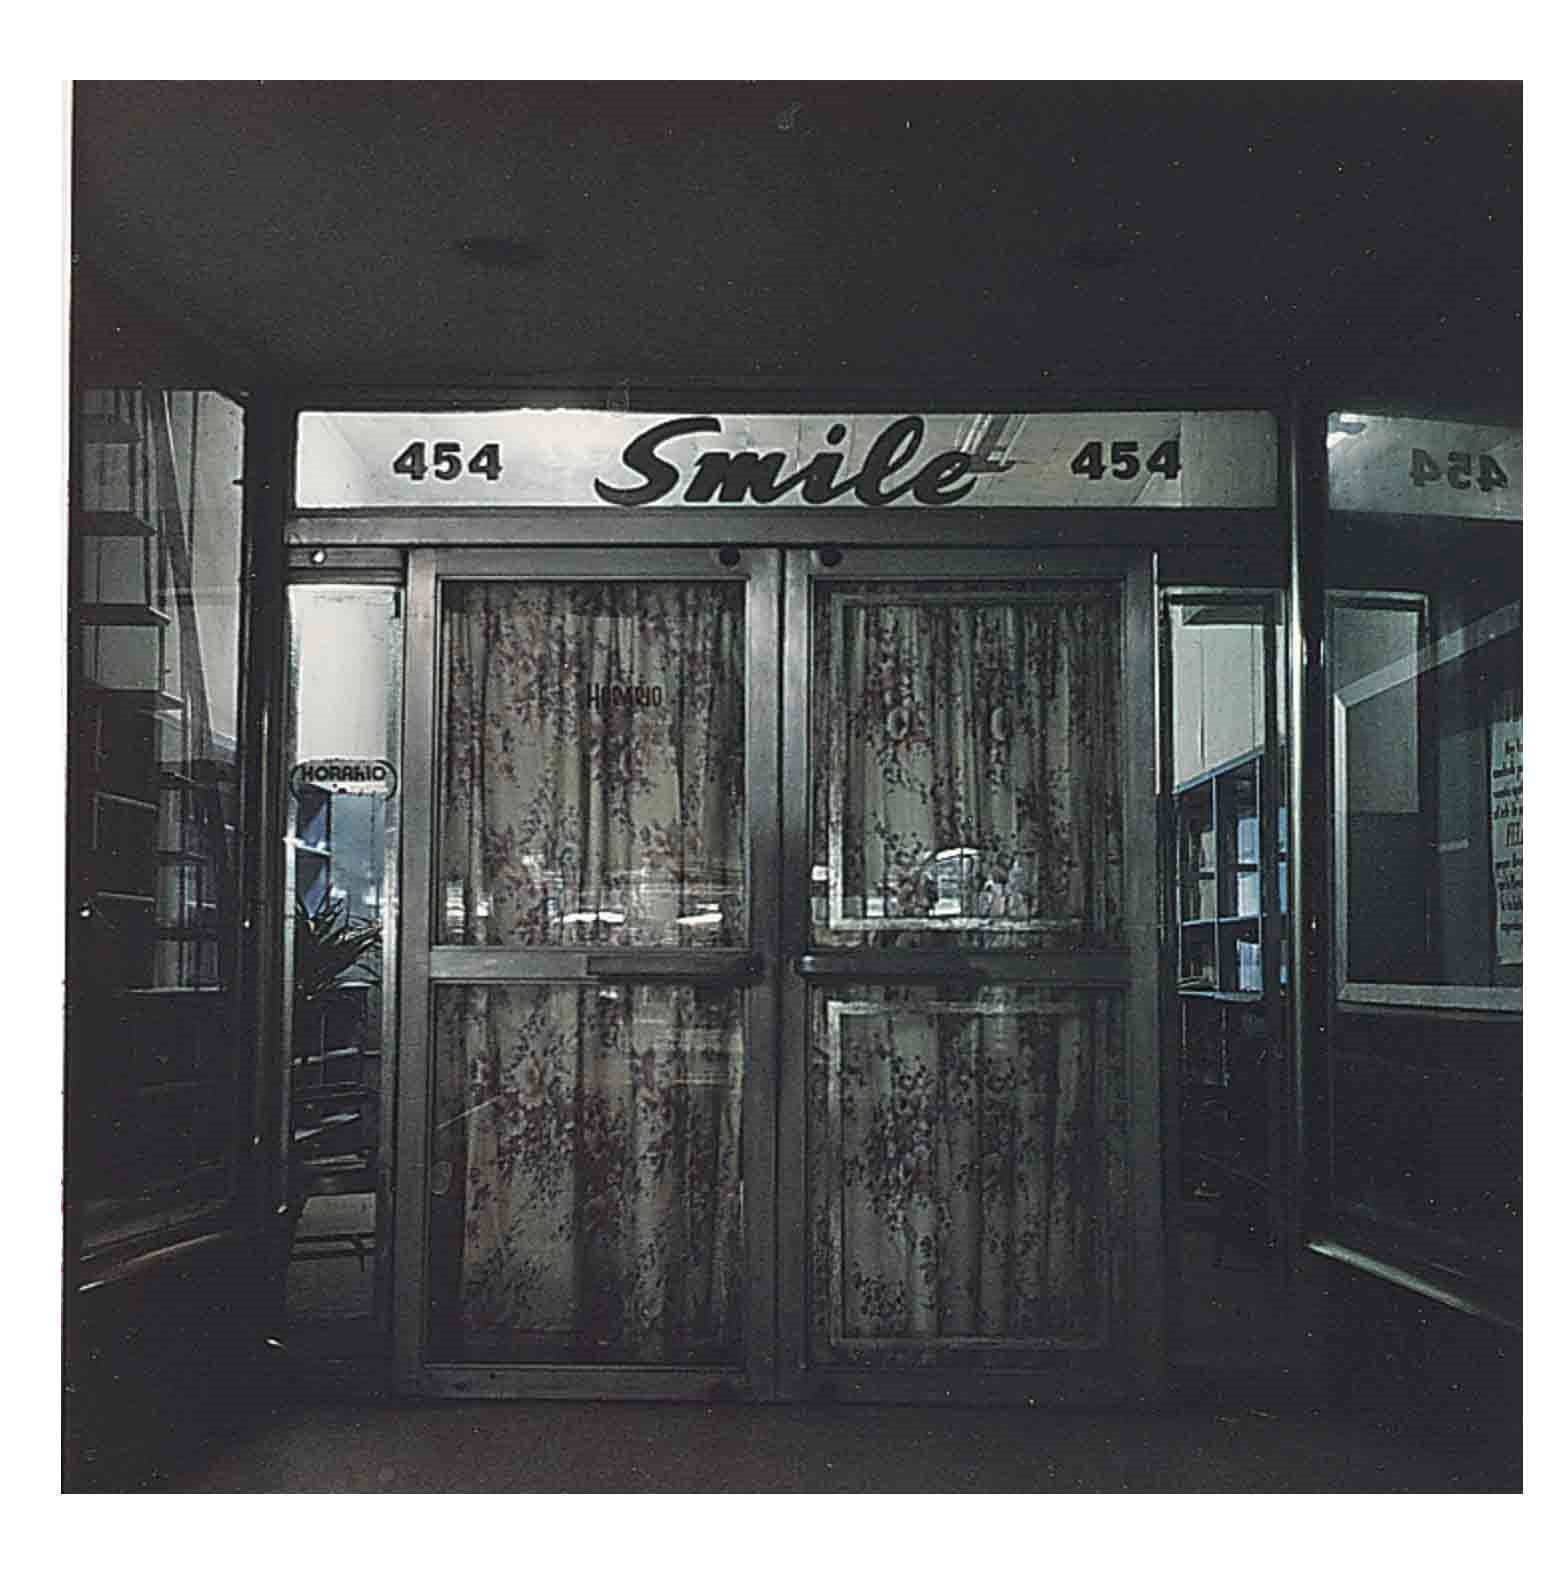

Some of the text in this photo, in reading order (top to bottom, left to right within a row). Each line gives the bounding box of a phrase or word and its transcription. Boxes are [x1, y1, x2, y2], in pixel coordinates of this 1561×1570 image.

[393, 415, 1182, 506] 454 Smile 454
